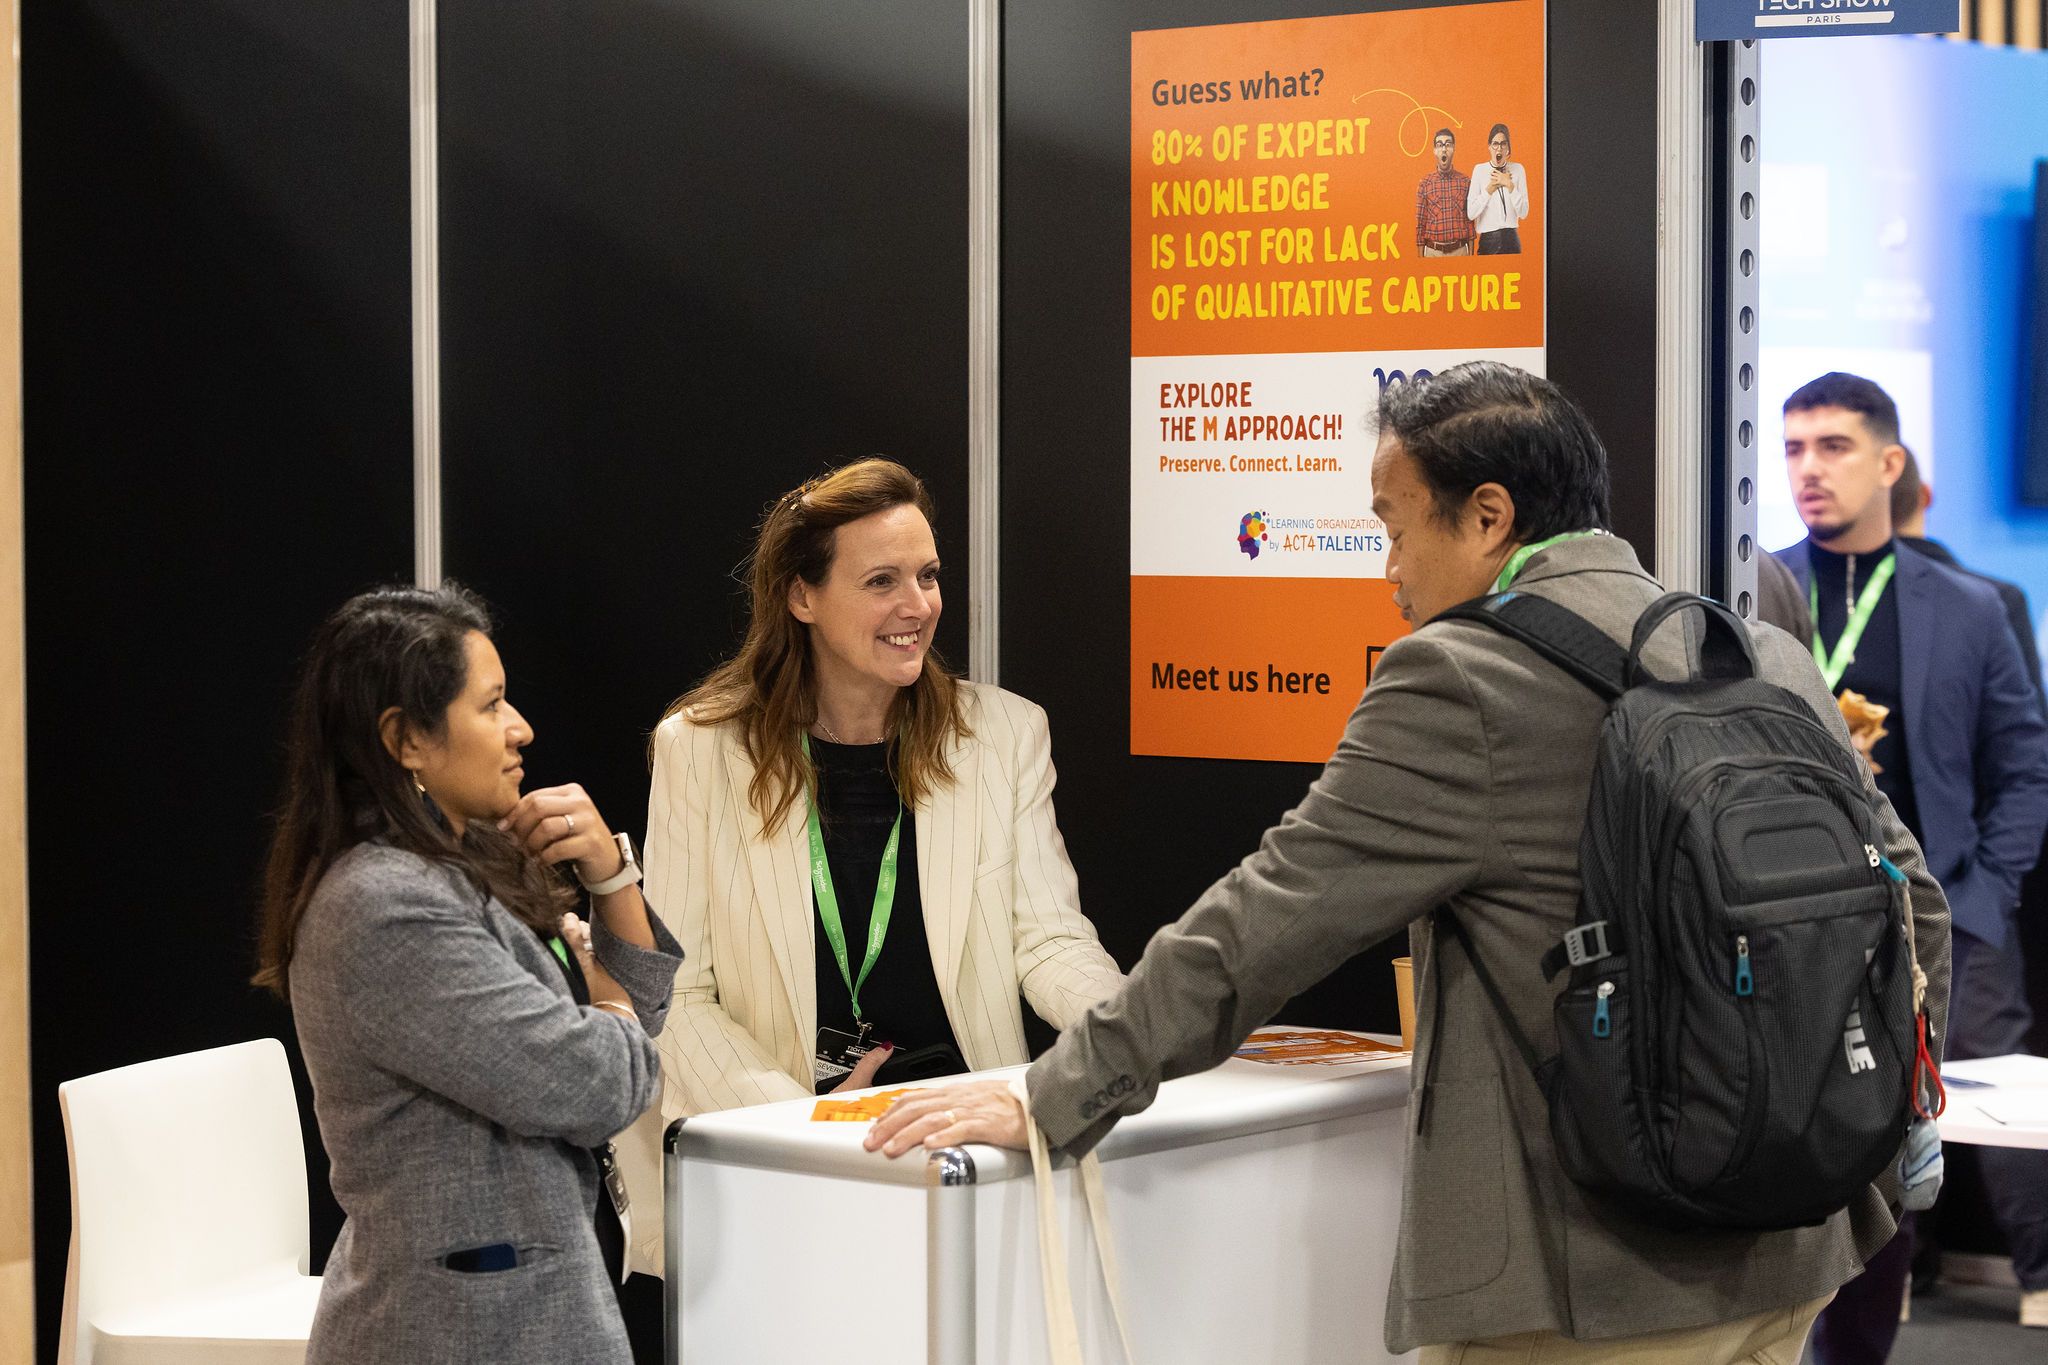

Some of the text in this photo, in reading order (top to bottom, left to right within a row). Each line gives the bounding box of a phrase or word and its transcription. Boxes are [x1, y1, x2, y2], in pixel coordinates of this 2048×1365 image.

[1806, 15, 1841, 24] PARIS
[1153, 69, 1323, 105] Guess what?
[1152, 118, 1370, 165] 80% OF EXPERT
[1152, 173, 1329, 217] KNOWLEDGE
[1152, 223, 1400, 269] IS LOST FOR LACK
[1152, 273, 1520, 320] OF QUALITATIVE CAPTURE
[1160, 382, 1252, 408] EXPLORE
[1160, 414, 1342, 442] THE M APPROACH!
[1160, 455, 1342, 472] Preserve. Connect. Learn.
[1271, 518, 1383, 530] LEARNING ORGANIZATION
[1269, 539, 1280, 552] by
[1152, 662, 1330, 694] Meet us here
